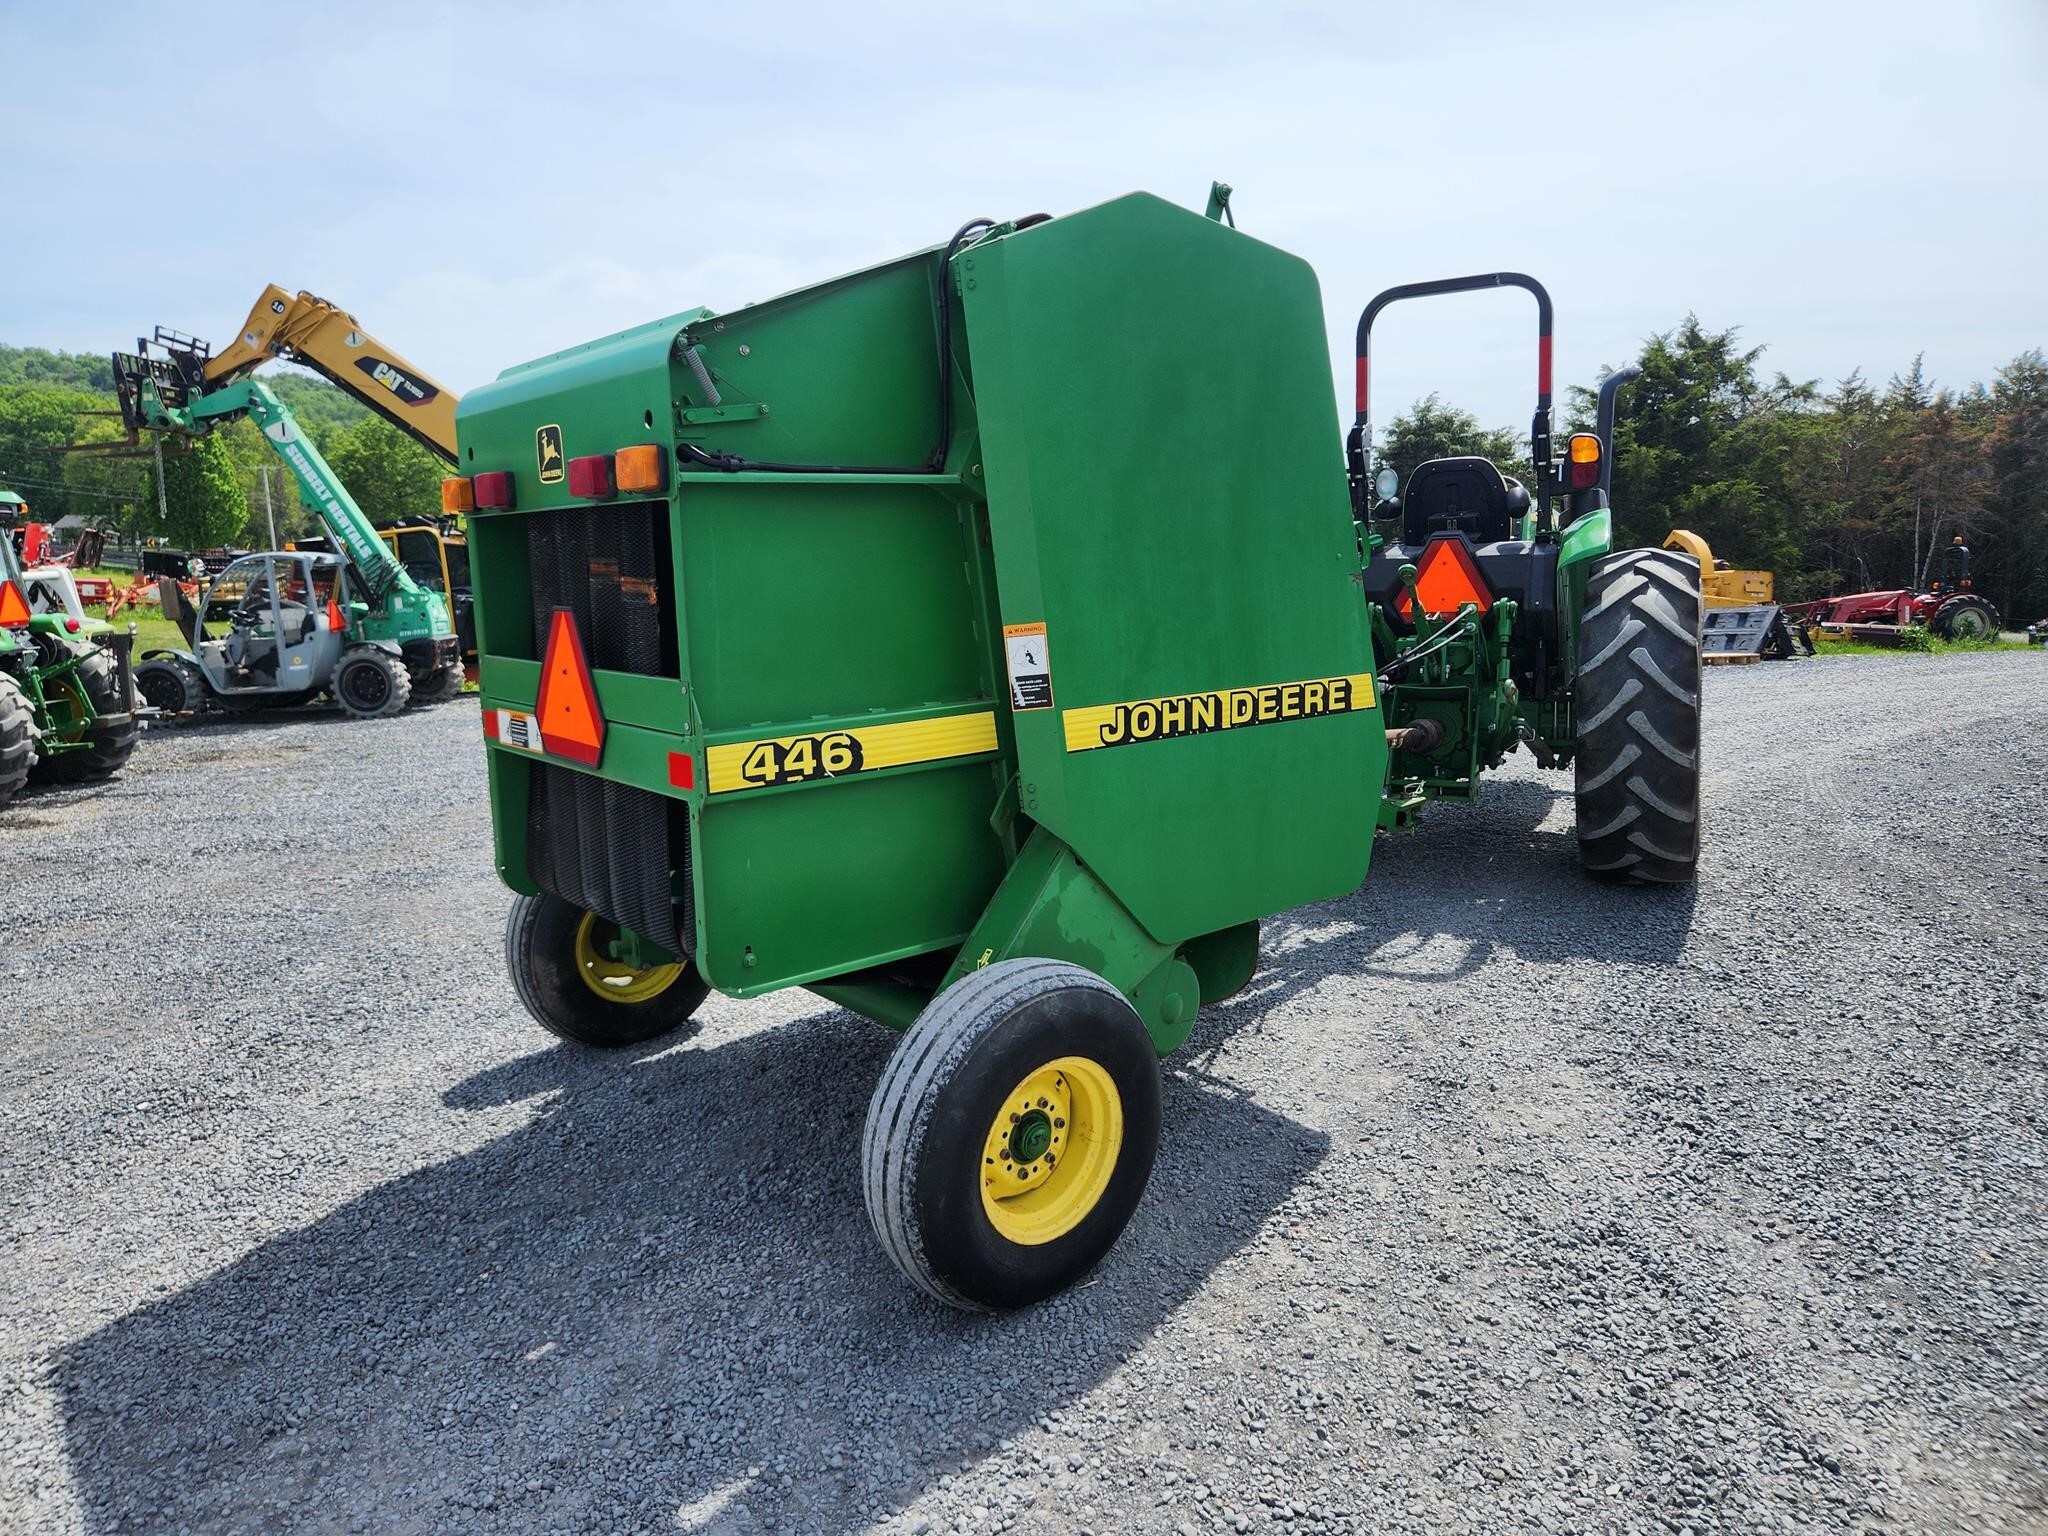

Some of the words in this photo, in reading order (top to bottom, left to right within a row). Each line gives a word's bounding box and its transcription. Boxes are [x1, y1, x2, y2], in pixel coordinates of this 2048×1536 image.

[272, 302, 285, 313] 10
[372, 362, 405, 392] CAT
[285, 443, 333, 501] SUNBELT
[326, 500, 373, 559] RENTALS
[1100, 694, 1219, 745] JOHN
[1230, 679, 1350, 727] DEERE
[742, 734, 860, 784] 446
